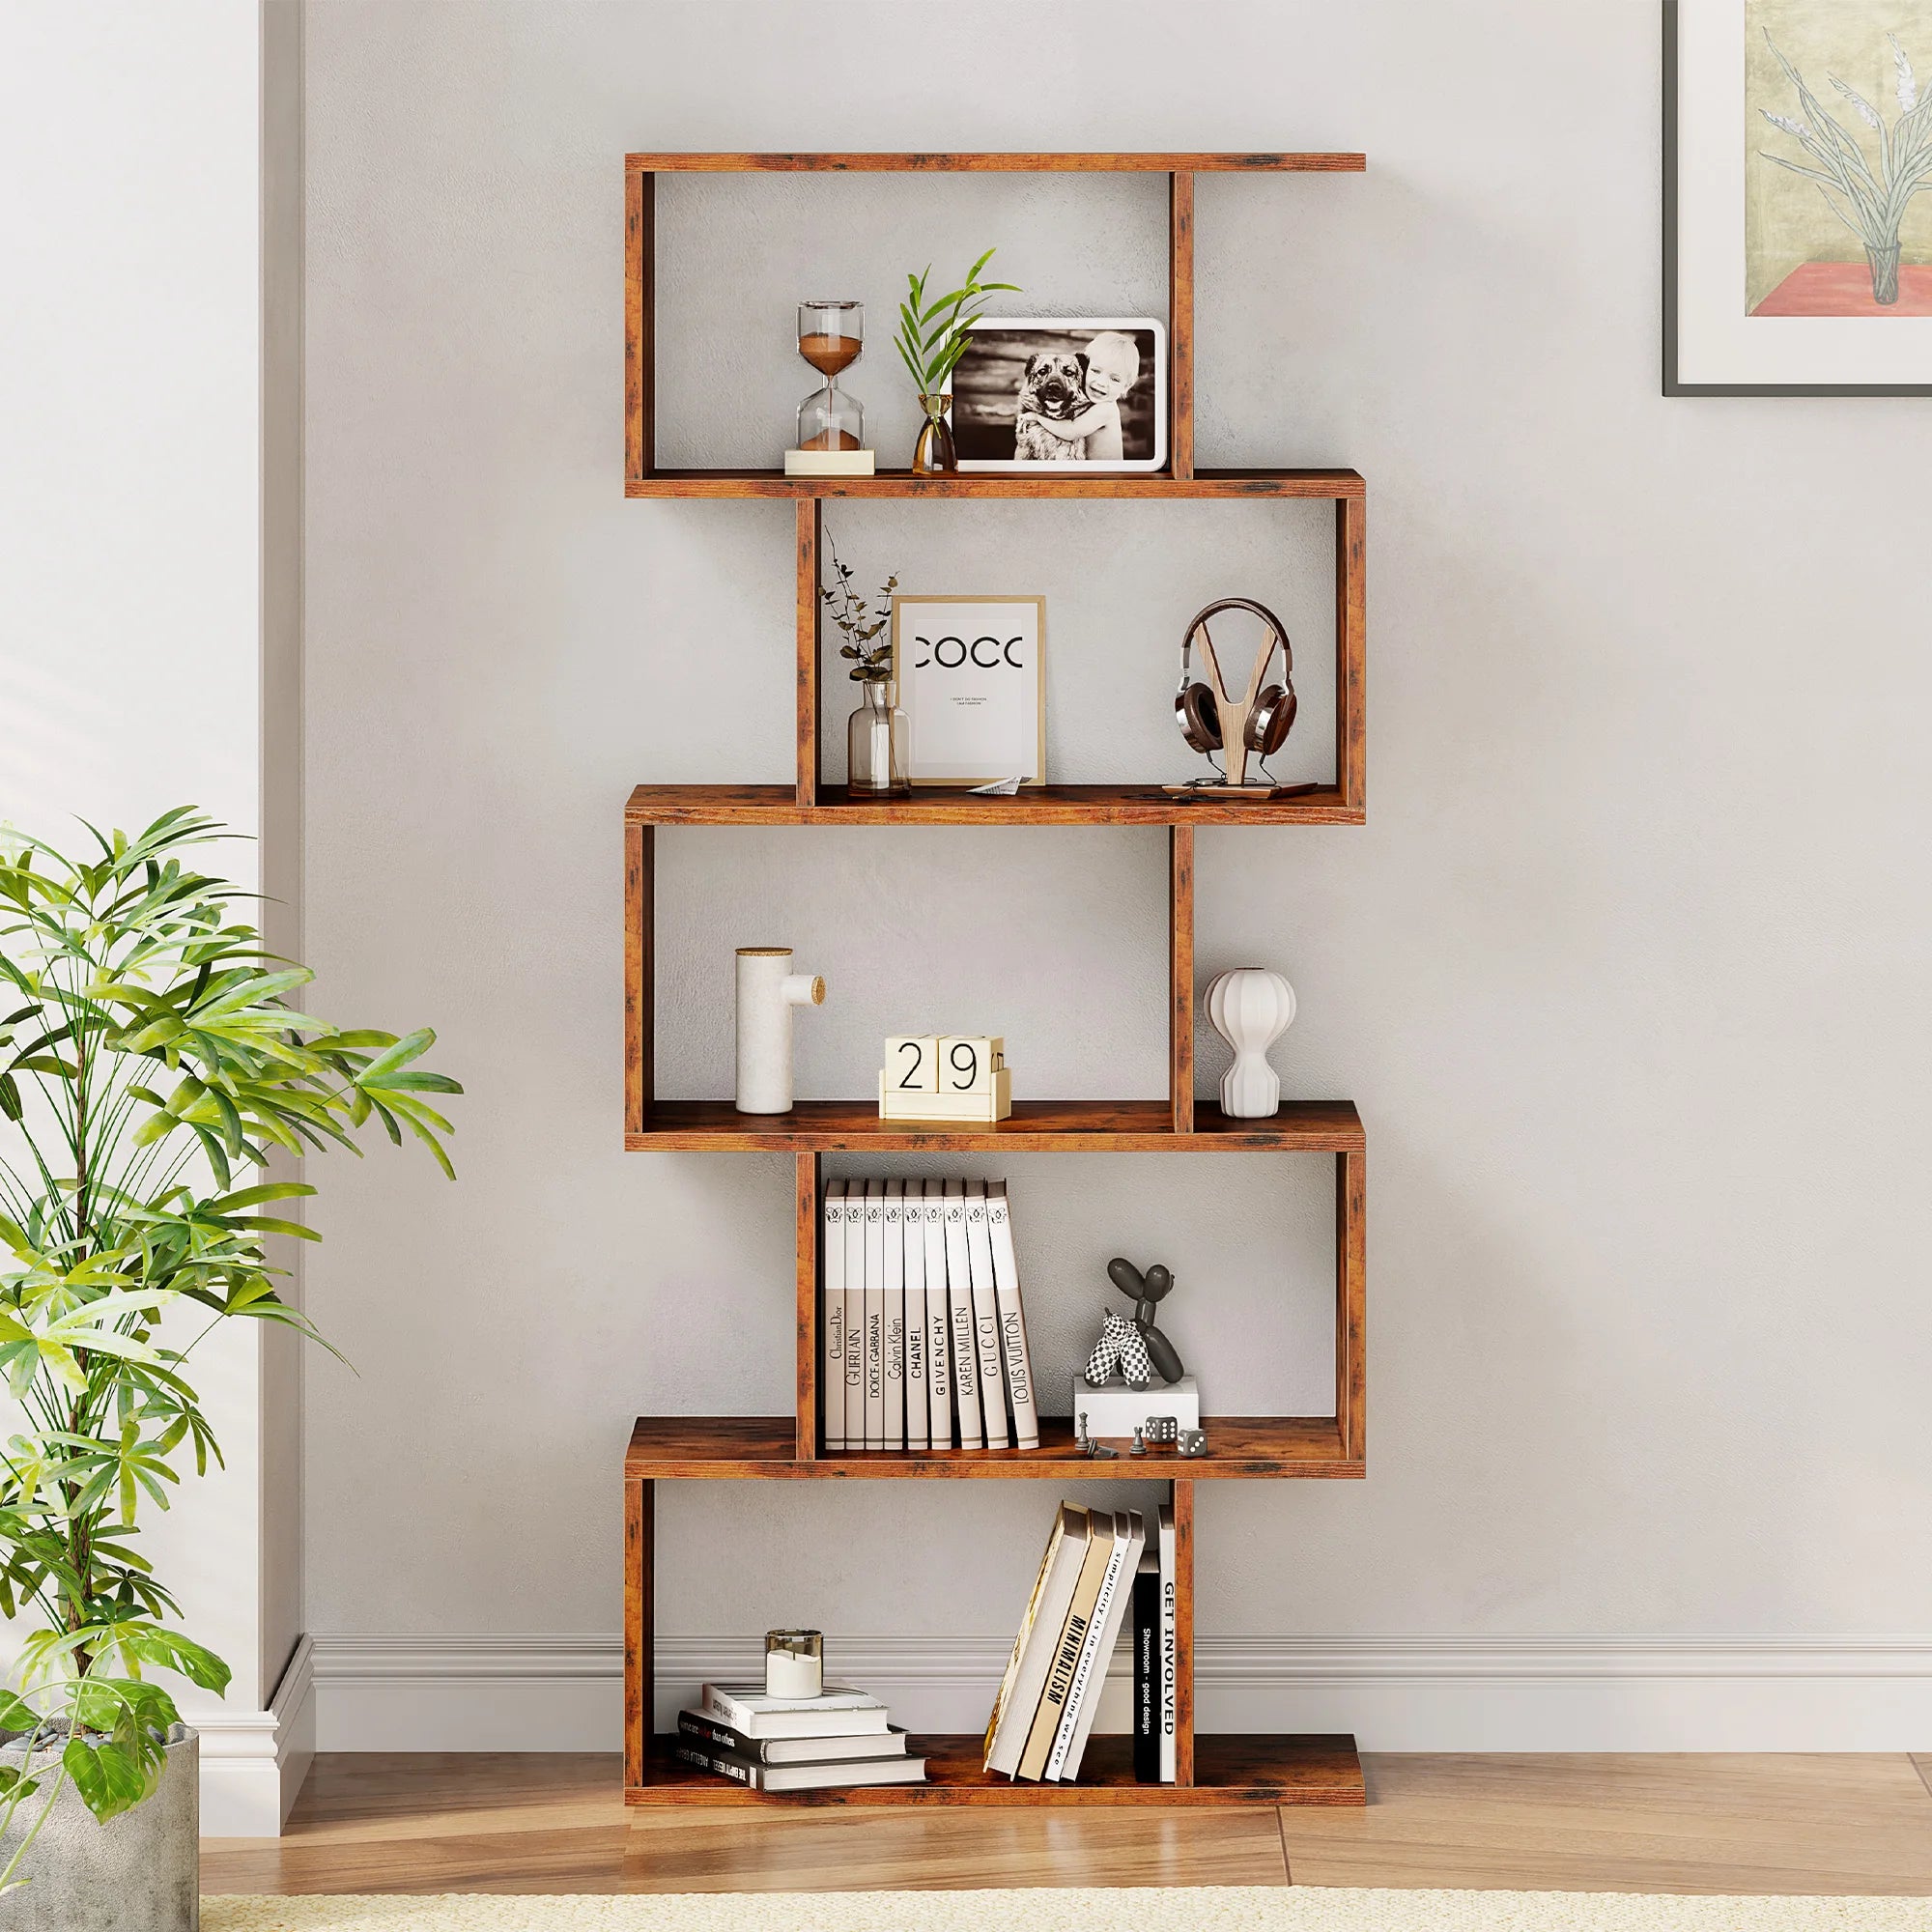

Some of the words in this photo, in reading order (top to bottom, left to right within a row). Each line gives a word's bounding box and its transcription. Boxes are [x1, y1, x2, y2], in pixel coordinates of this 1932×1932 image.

[888, 1318, 901, 1344] Klein
[954, 1307, 971, 1351] MILLEN
[980, 1316, 998, 1377] GUCCI
[1003, 1312, 1024, 1366] VUITTON
[888, 1346, 901, 1379] Calvin
[911, 1327, 922, 1378] CHANEL
[933, 1316, 946, 1396] GIVENCHY
[958, 1356, 974, 1396] KAREN
[1010, 1369, 1029, 1405] LOUIS
[1097, 1551, 1121, 1615] simplicity
[1165, 1581, 1175, 1621] GET
[1089, 1635, 1097, 1646] in
[1094, 1620, 1102, 1630] is
[1047, 1614, 1087, 1705] MINIMALISM
[1143, 1628, 1151, 1674] Showroom
[1066, 1652, 1092, 1719] everything
[1142, 1683, 1151, 1704] good
[1165, 1628, 1175, 1735] INVOLVED
[1062, 1723, 1069, 1740] we
[1142, 1706, 1151, 1735] design
